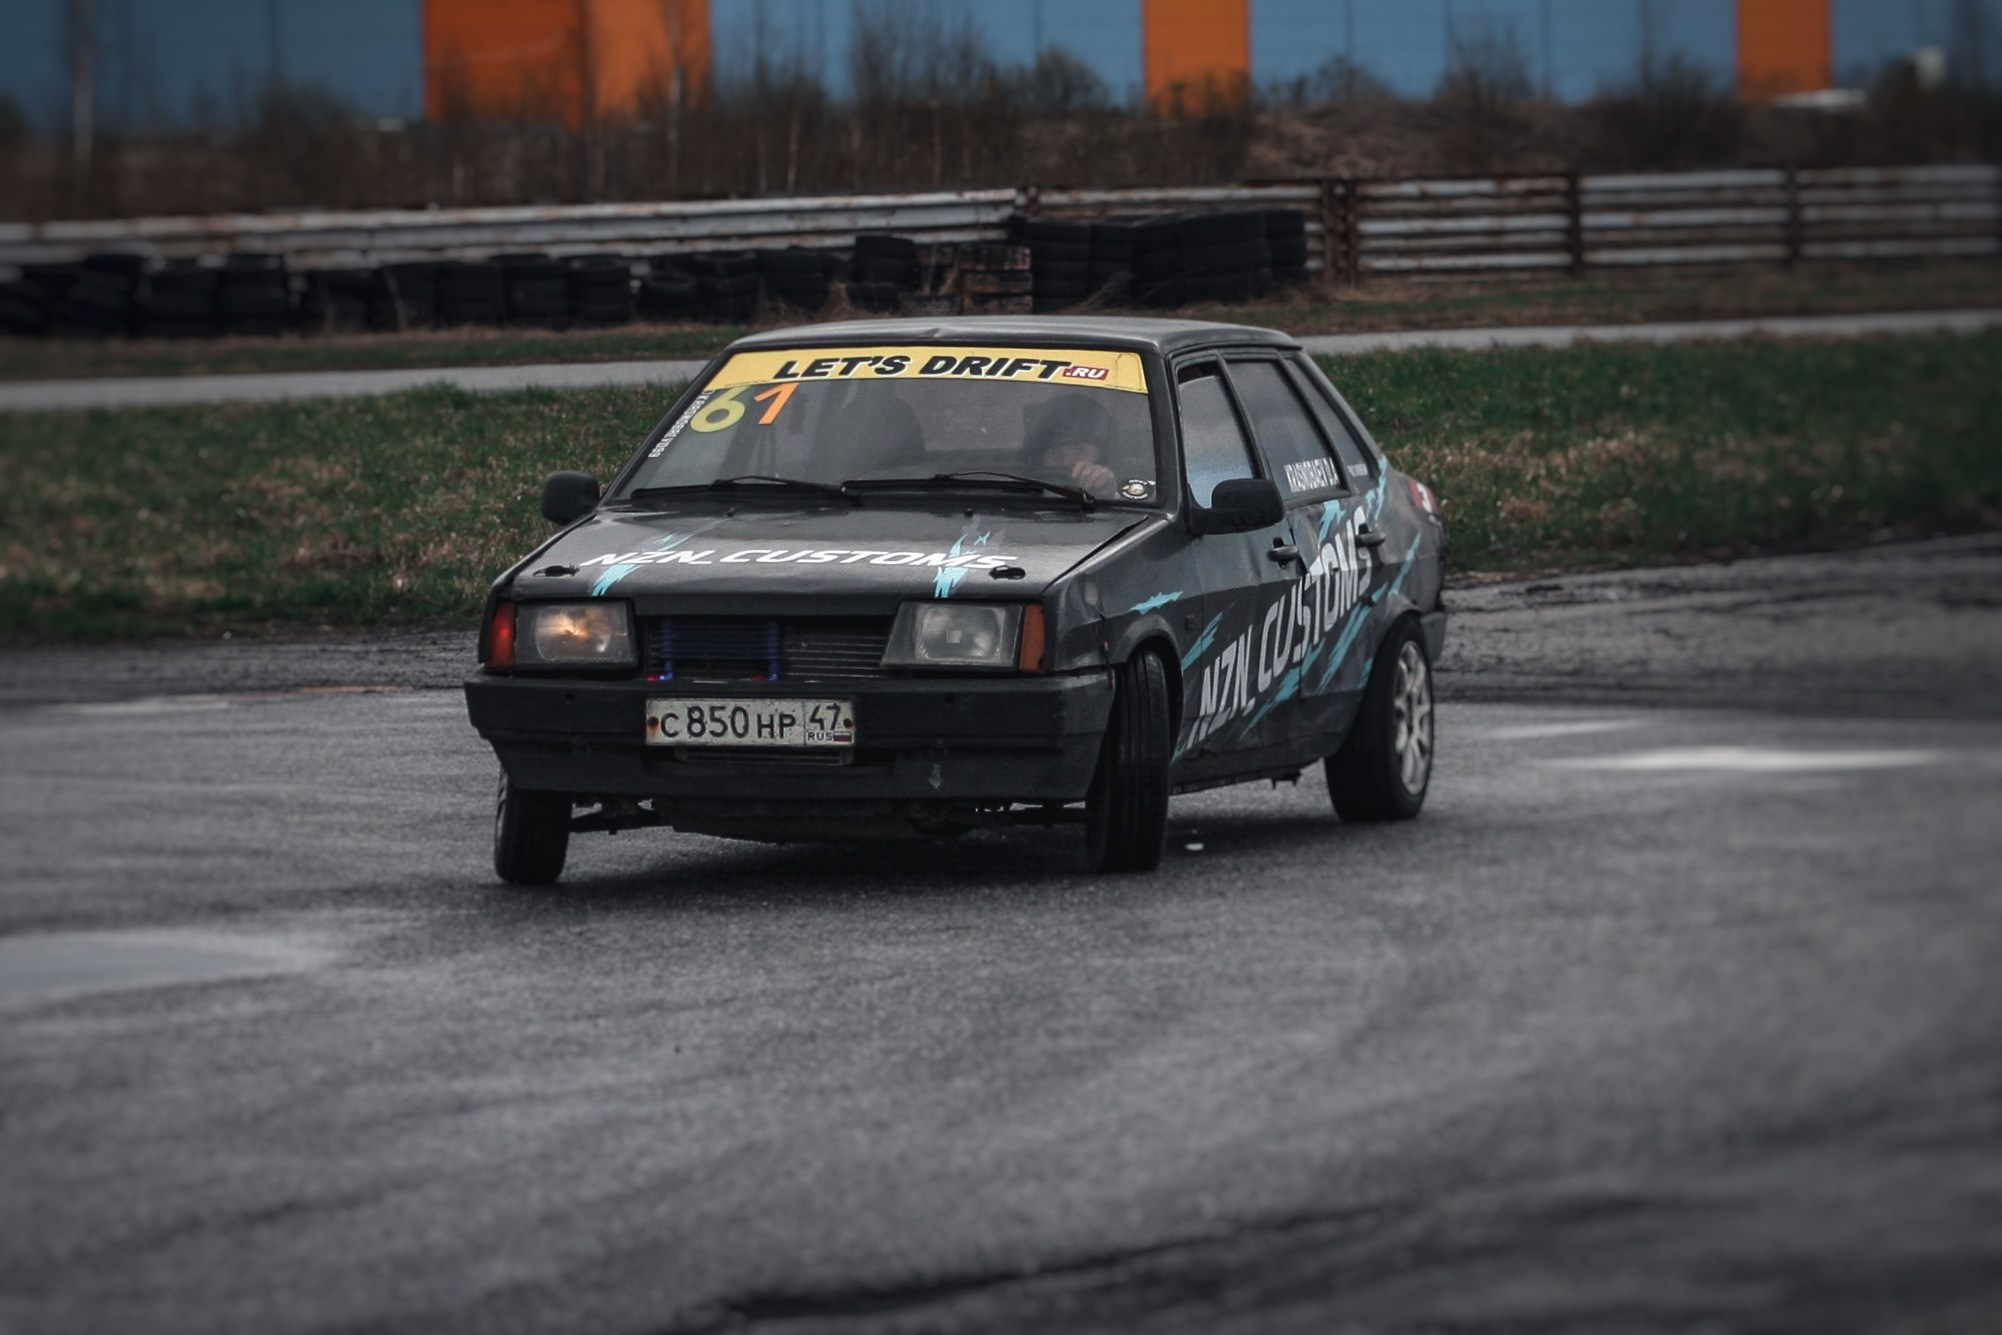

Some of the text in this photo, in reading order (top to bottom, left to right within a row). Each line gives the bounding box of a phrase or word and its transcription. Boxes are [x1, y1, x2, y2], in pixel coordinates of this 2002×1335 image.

[772, 355, 911, 380] LET'S
[808, 703, 842, 731] 47
[807, 731, 832, 742] RUS
